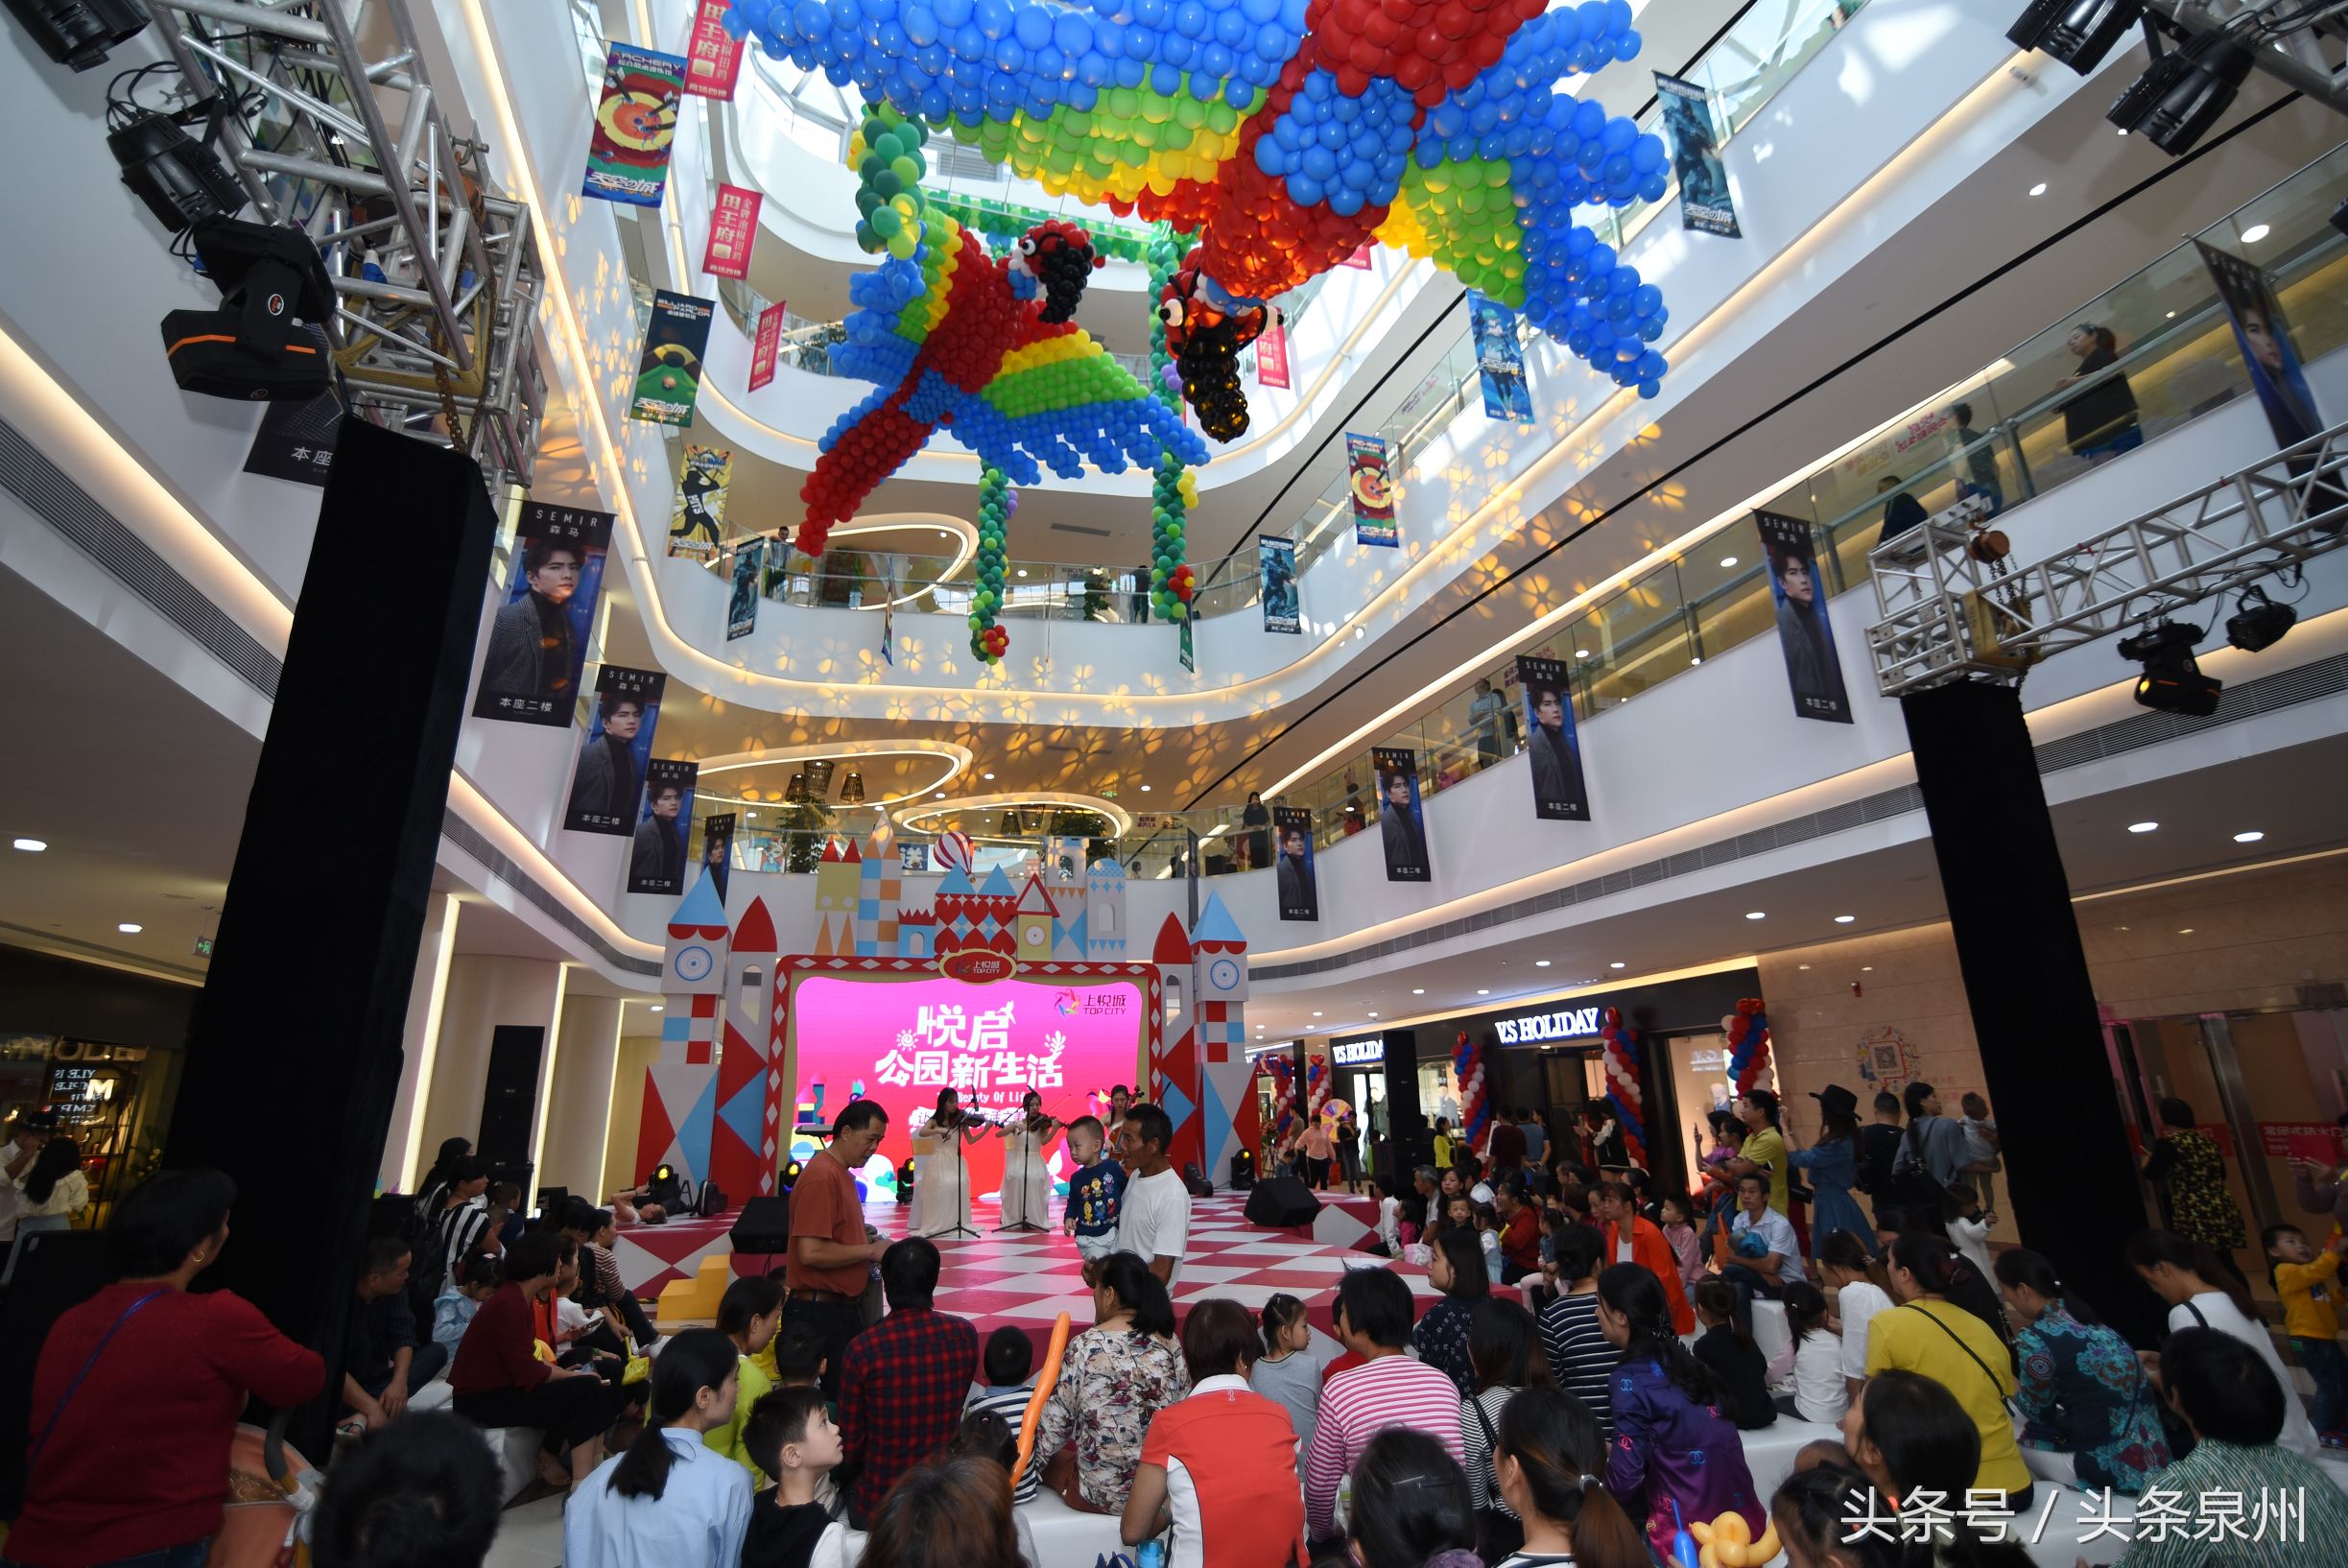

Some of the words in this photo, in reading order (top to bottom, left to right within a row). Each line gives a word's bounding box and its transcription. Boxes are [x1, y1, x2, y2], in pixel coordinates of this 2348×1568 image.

[718, 193, 742, 243] 田王府
[291, 446, 334, 466] 本座
[535, 509, 599, 528] SEMIR
[1764, 516, 1805, 535] SEMIR
[549, 524, 580, 537] 森马
[1526, 660, 1560, 673] SEMIR
[608, 670, 655, 684] SEMIR
[500, 697, 554, 713] 本座二楼
[653, 762, 690, 772] SEMIR
[1082, 994, 1127, 1007] 上悦城
[916, 1003, 1011, 1053] 悦启
[1517, 1008, 1599, 1041] HOLIDAY
[874, 1048, 1064, 1089] 公园新生活
[85, 1079, 114, 1101] M
[957, 1091, 989, 1104] Beaty
[993, 1091, 1005, 1103] Of
